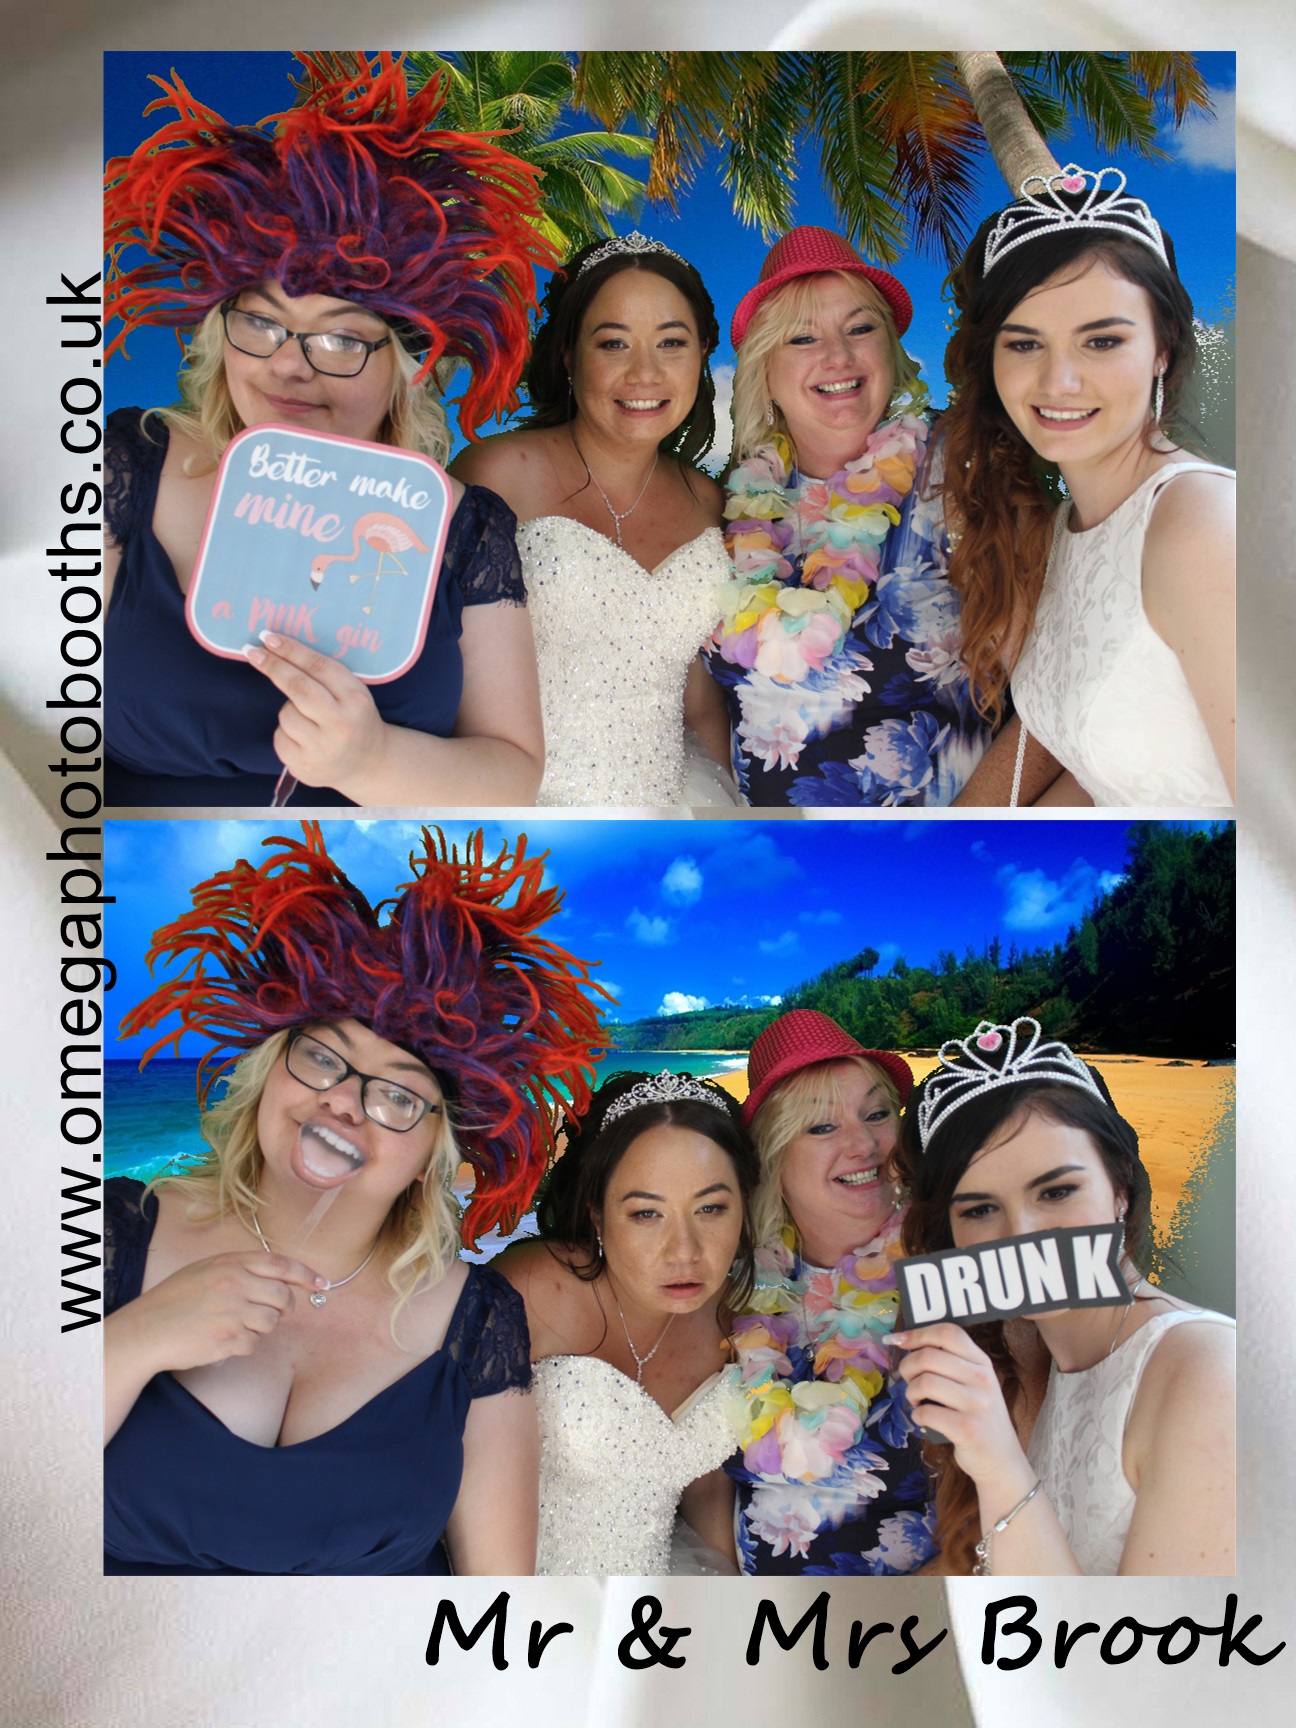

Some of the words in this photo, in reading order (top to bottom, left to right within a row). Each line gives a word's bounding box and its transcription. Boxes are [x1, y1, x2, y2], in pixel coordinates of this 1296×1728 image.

[248, 443, 338, 488] Better
[349, 474, 431, 510] make
[234, 490, 346, 543] mine
[211, 600, 235, 621] a
[332, 622, 384, 660] gin
[903, 1233, 1121, 1324] DRUNK
